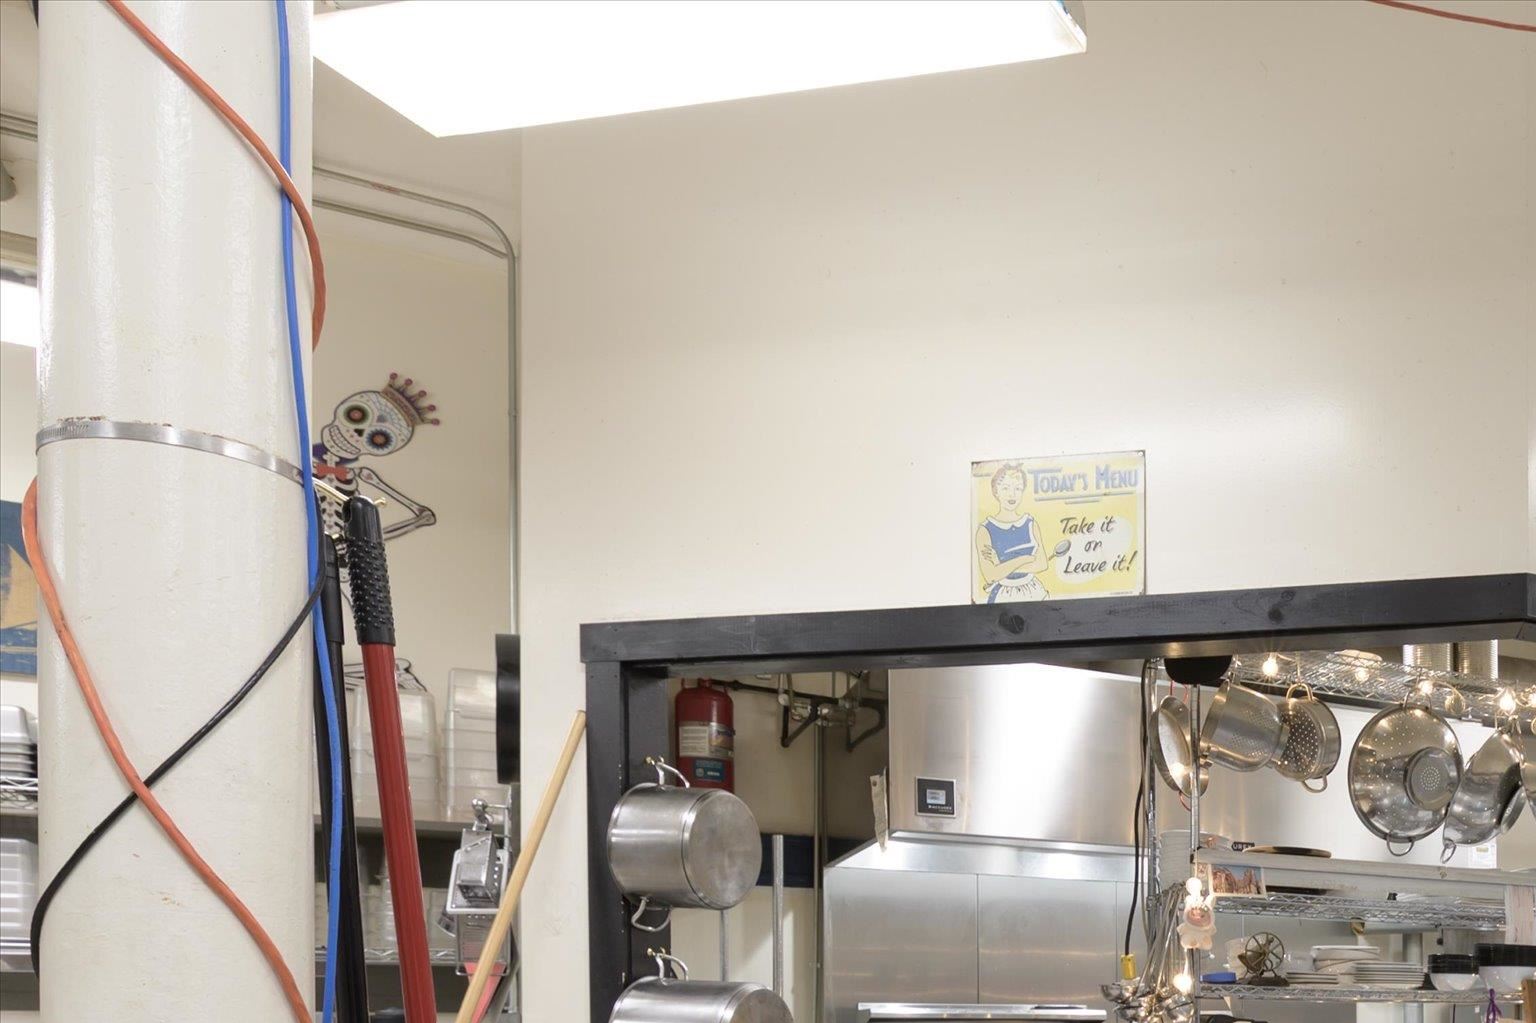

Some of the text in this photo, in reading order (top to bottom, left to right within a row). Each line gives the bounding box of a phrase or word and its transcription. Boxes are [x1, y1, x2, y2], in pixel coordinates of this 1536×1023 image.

[1095, 465, 1139, 490] MENU
[1060, 515, 1116, 535] Take it
[1084, 540, 1102, 552] or
[1063, 550, 1138, 574] Leave it!
